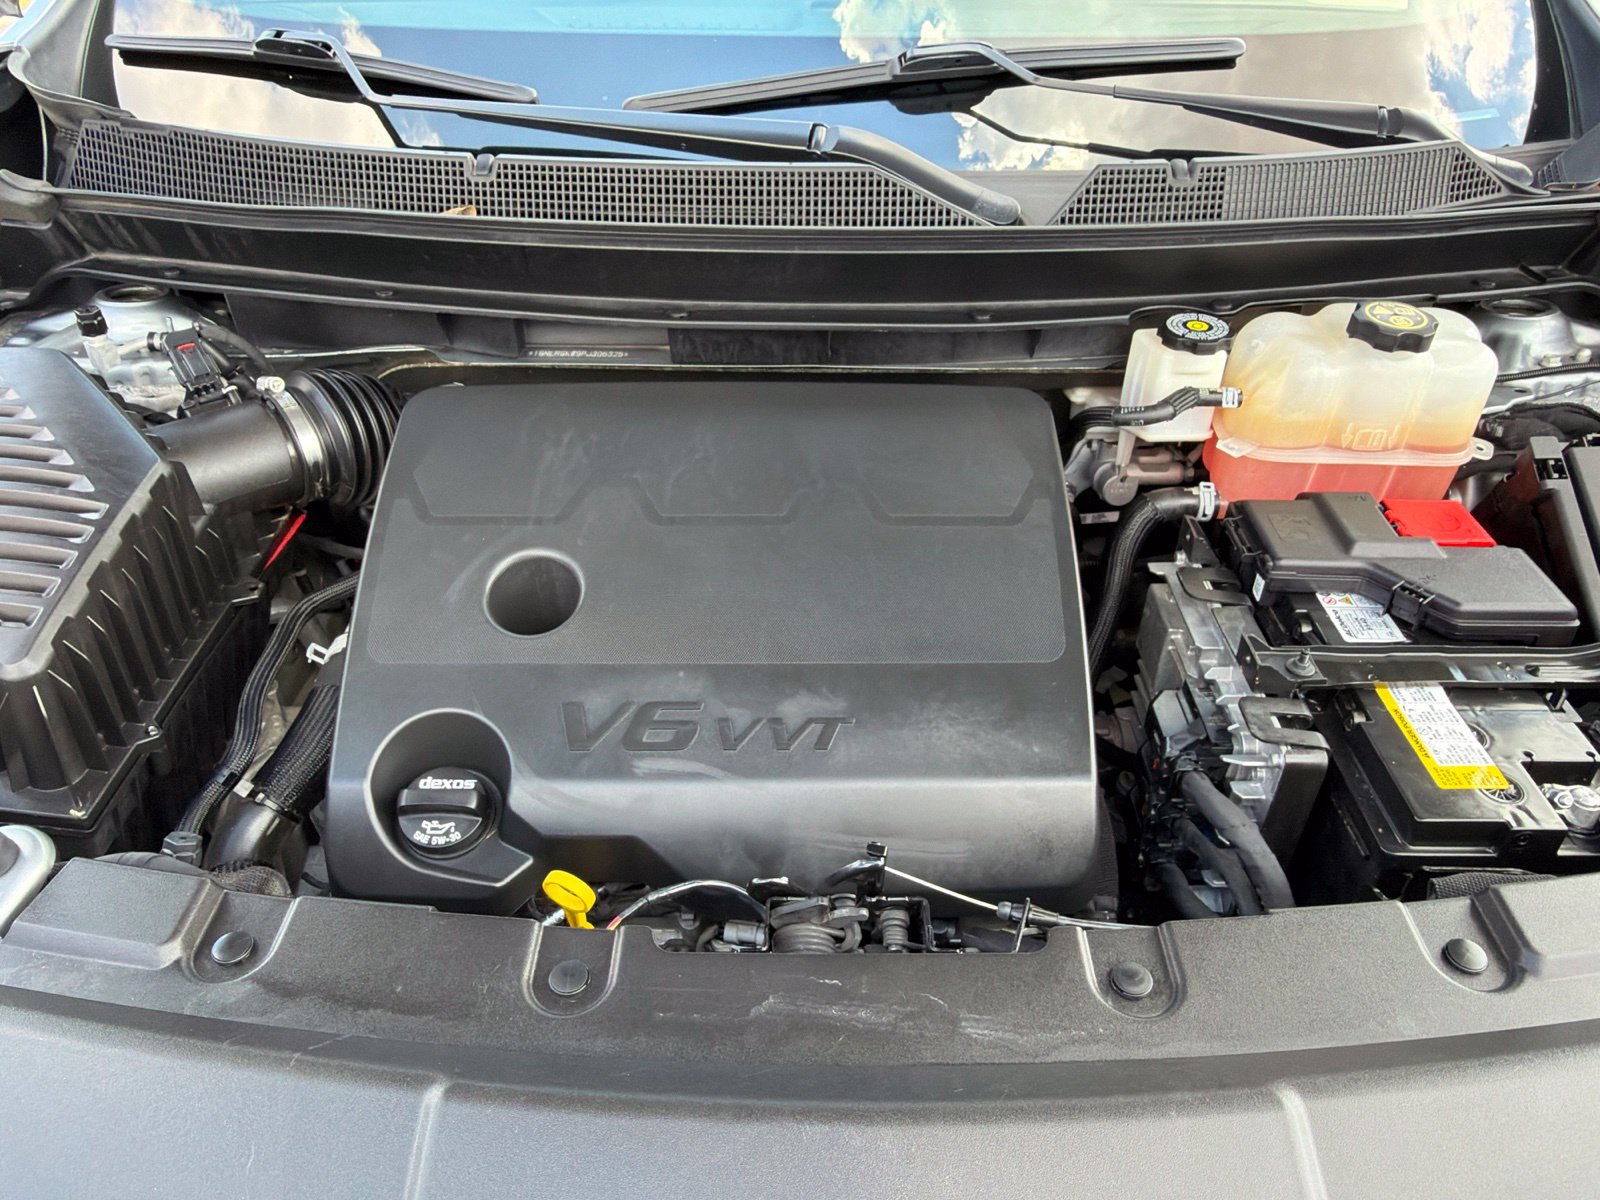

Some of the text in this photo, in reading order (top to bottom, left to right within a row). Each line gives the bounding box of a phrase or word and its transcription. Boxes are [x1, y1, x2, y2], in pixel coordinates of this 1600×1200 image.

[560, 701, 856, 752] V6 VVT
[1406, 729, 1426, 753] DANGER
[418, 776, 478, 790] dexos
[413, 830, 462, 845] SAE 5W-30
